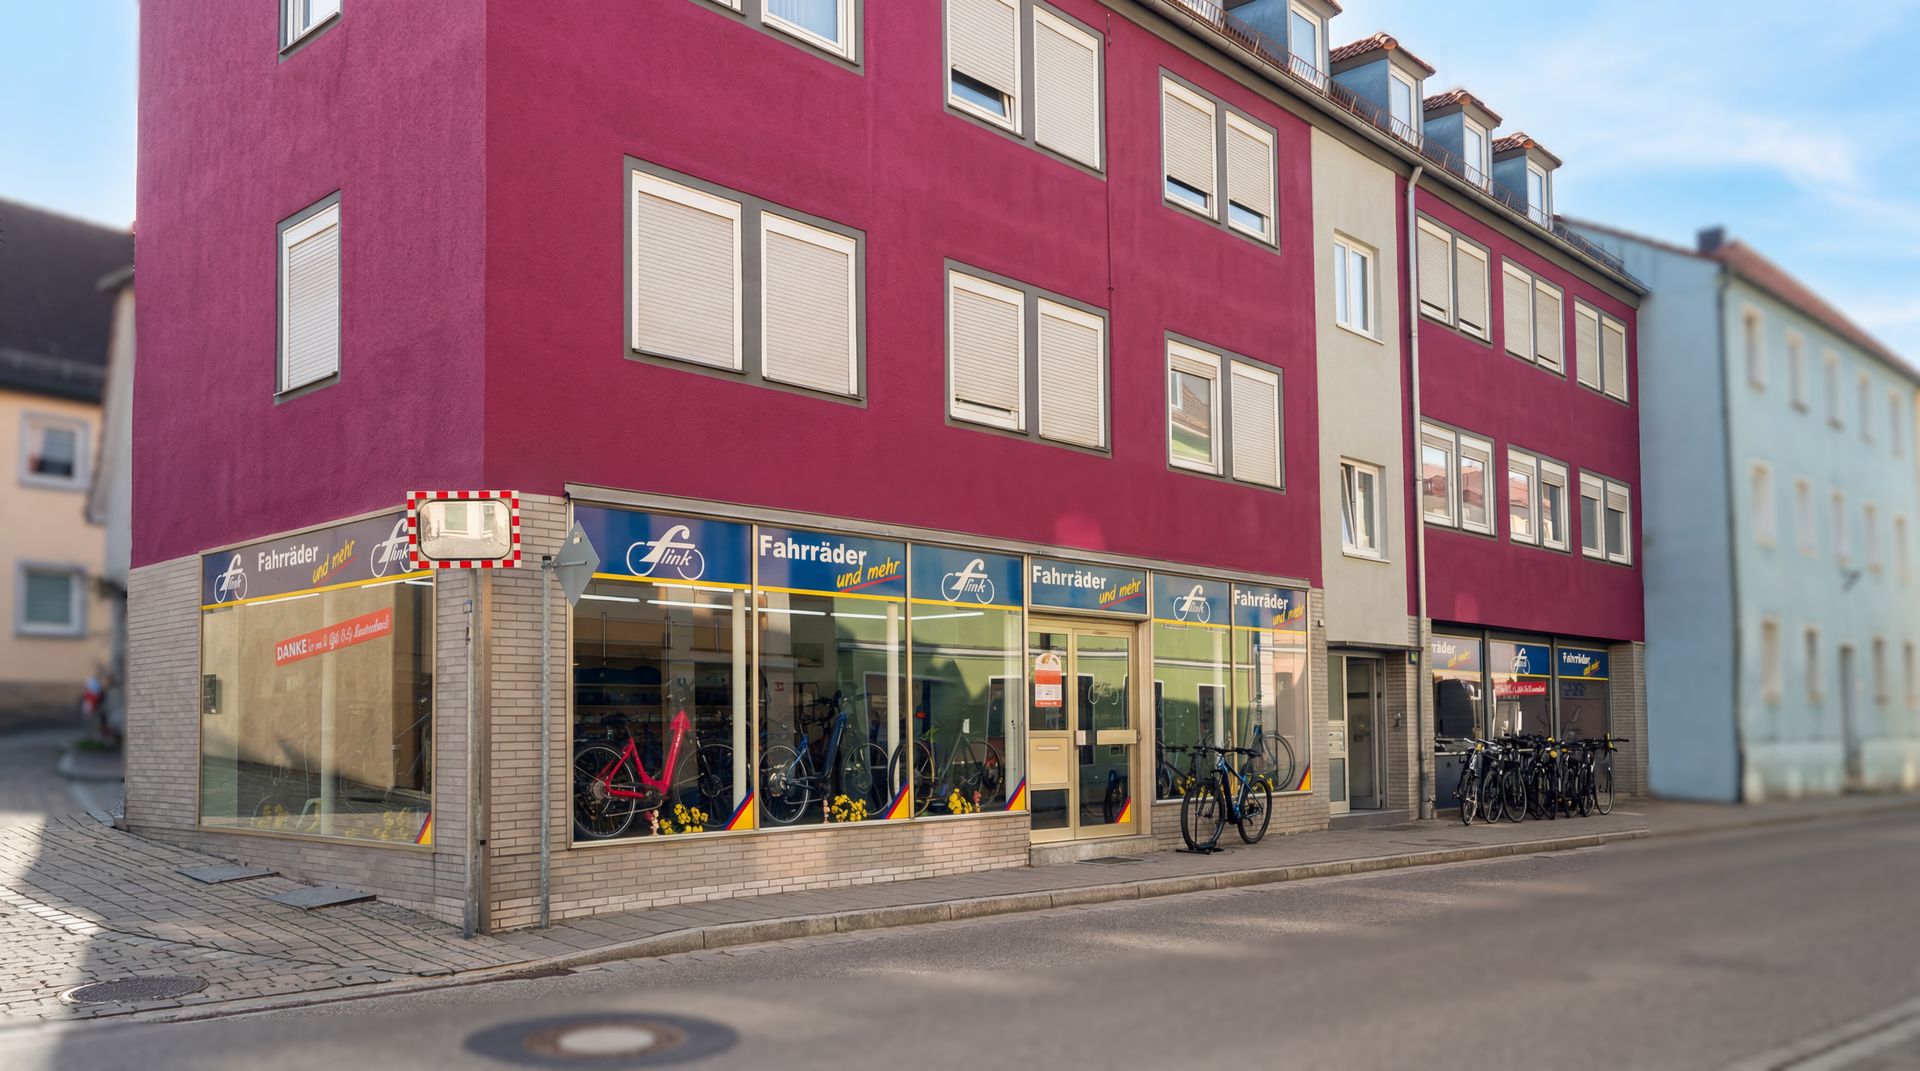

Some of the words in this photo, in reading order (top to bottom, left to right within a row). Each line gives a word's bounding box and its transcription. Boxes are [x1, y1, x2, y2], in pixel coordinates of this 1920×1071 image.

[258, 543, 319, 572] Fahrräder
[639, 524, 696, 567] flink
[760, 534, 867, 566] Fahrräder
[312, 559, 329, 585] und
[332, 537, 355, 570] mehr
[836, 565, 862, 588] und
[867, 556, 901, 580] mehr
[951, 558, 988, 594] flink
[1033, 565, 1107, 590] Fahrräder
[1098, 584, 1117, 604] und
[1119, 577, 1143, 599] mehr
[1234, 589, 1289, 610] Fahrräder
[1272, 611, 1286, 626] und
[277, 639, 307, 661] DANKE
